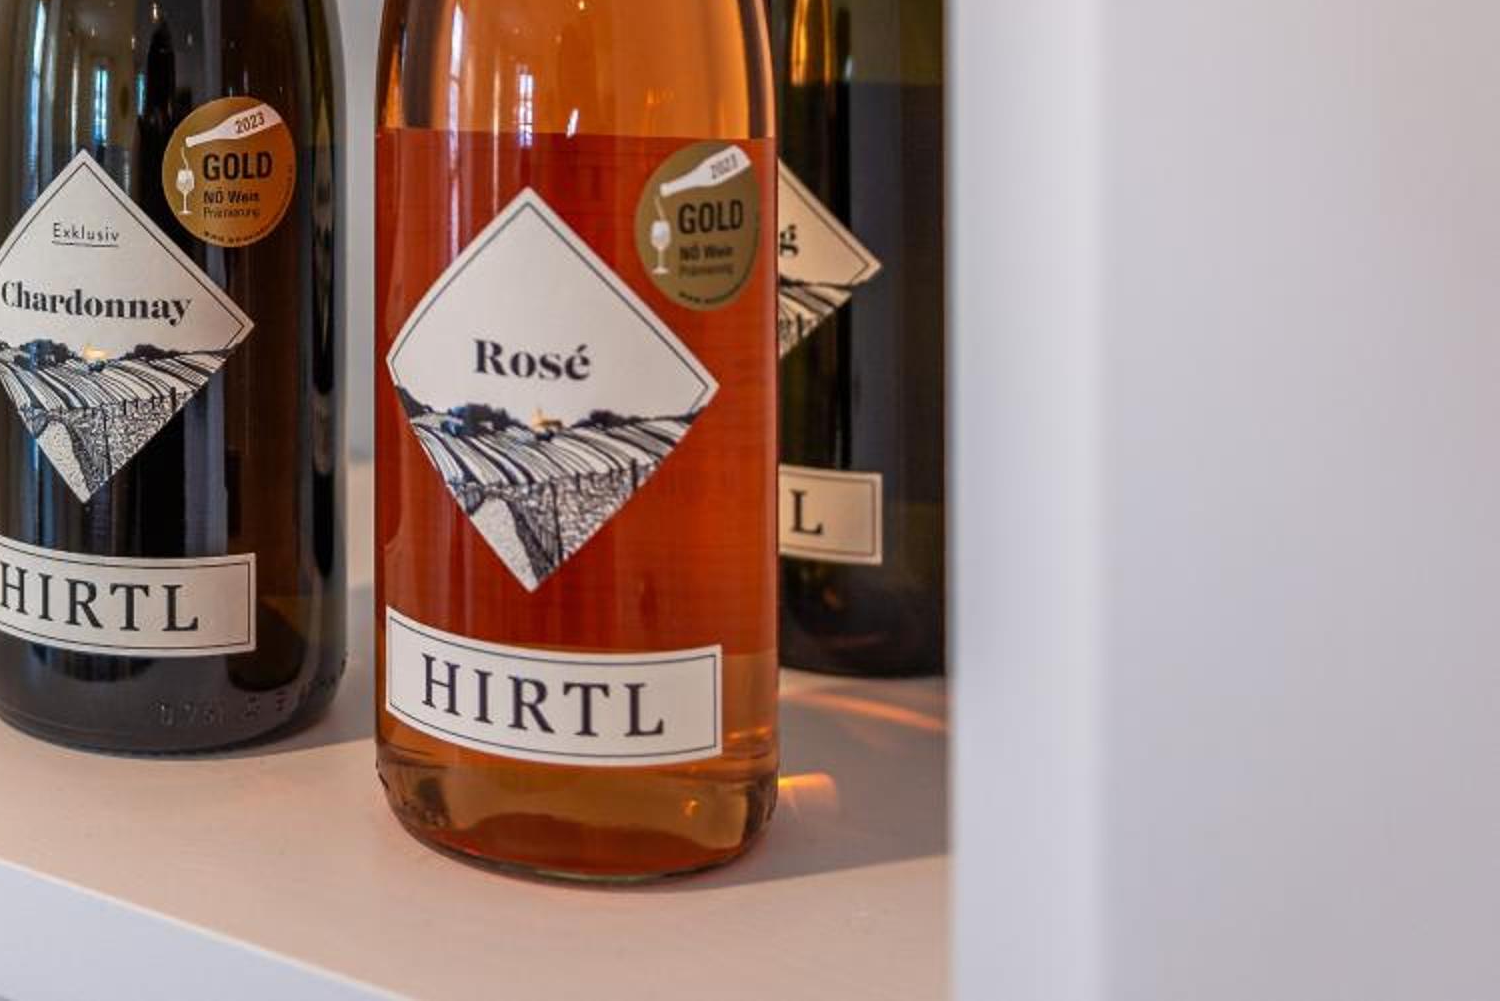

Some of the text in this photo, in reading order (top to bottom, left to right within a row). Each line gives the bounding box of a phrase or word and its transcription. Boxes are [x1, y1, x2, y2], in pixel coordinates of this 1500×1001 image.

[235, 112, 265, 134] 2023
[203, 152, 273, 181] GOLD
[53, 222, 120, 242] Exklusiv
[678, 199, 744, 235] GOLD
[0, 279, 193, 328] Chardonnay
[472, 337, 592, 381] Rosé
[0, 560, 199, 632] HIRTL
[420, 651, 666, 738] HIRTL
